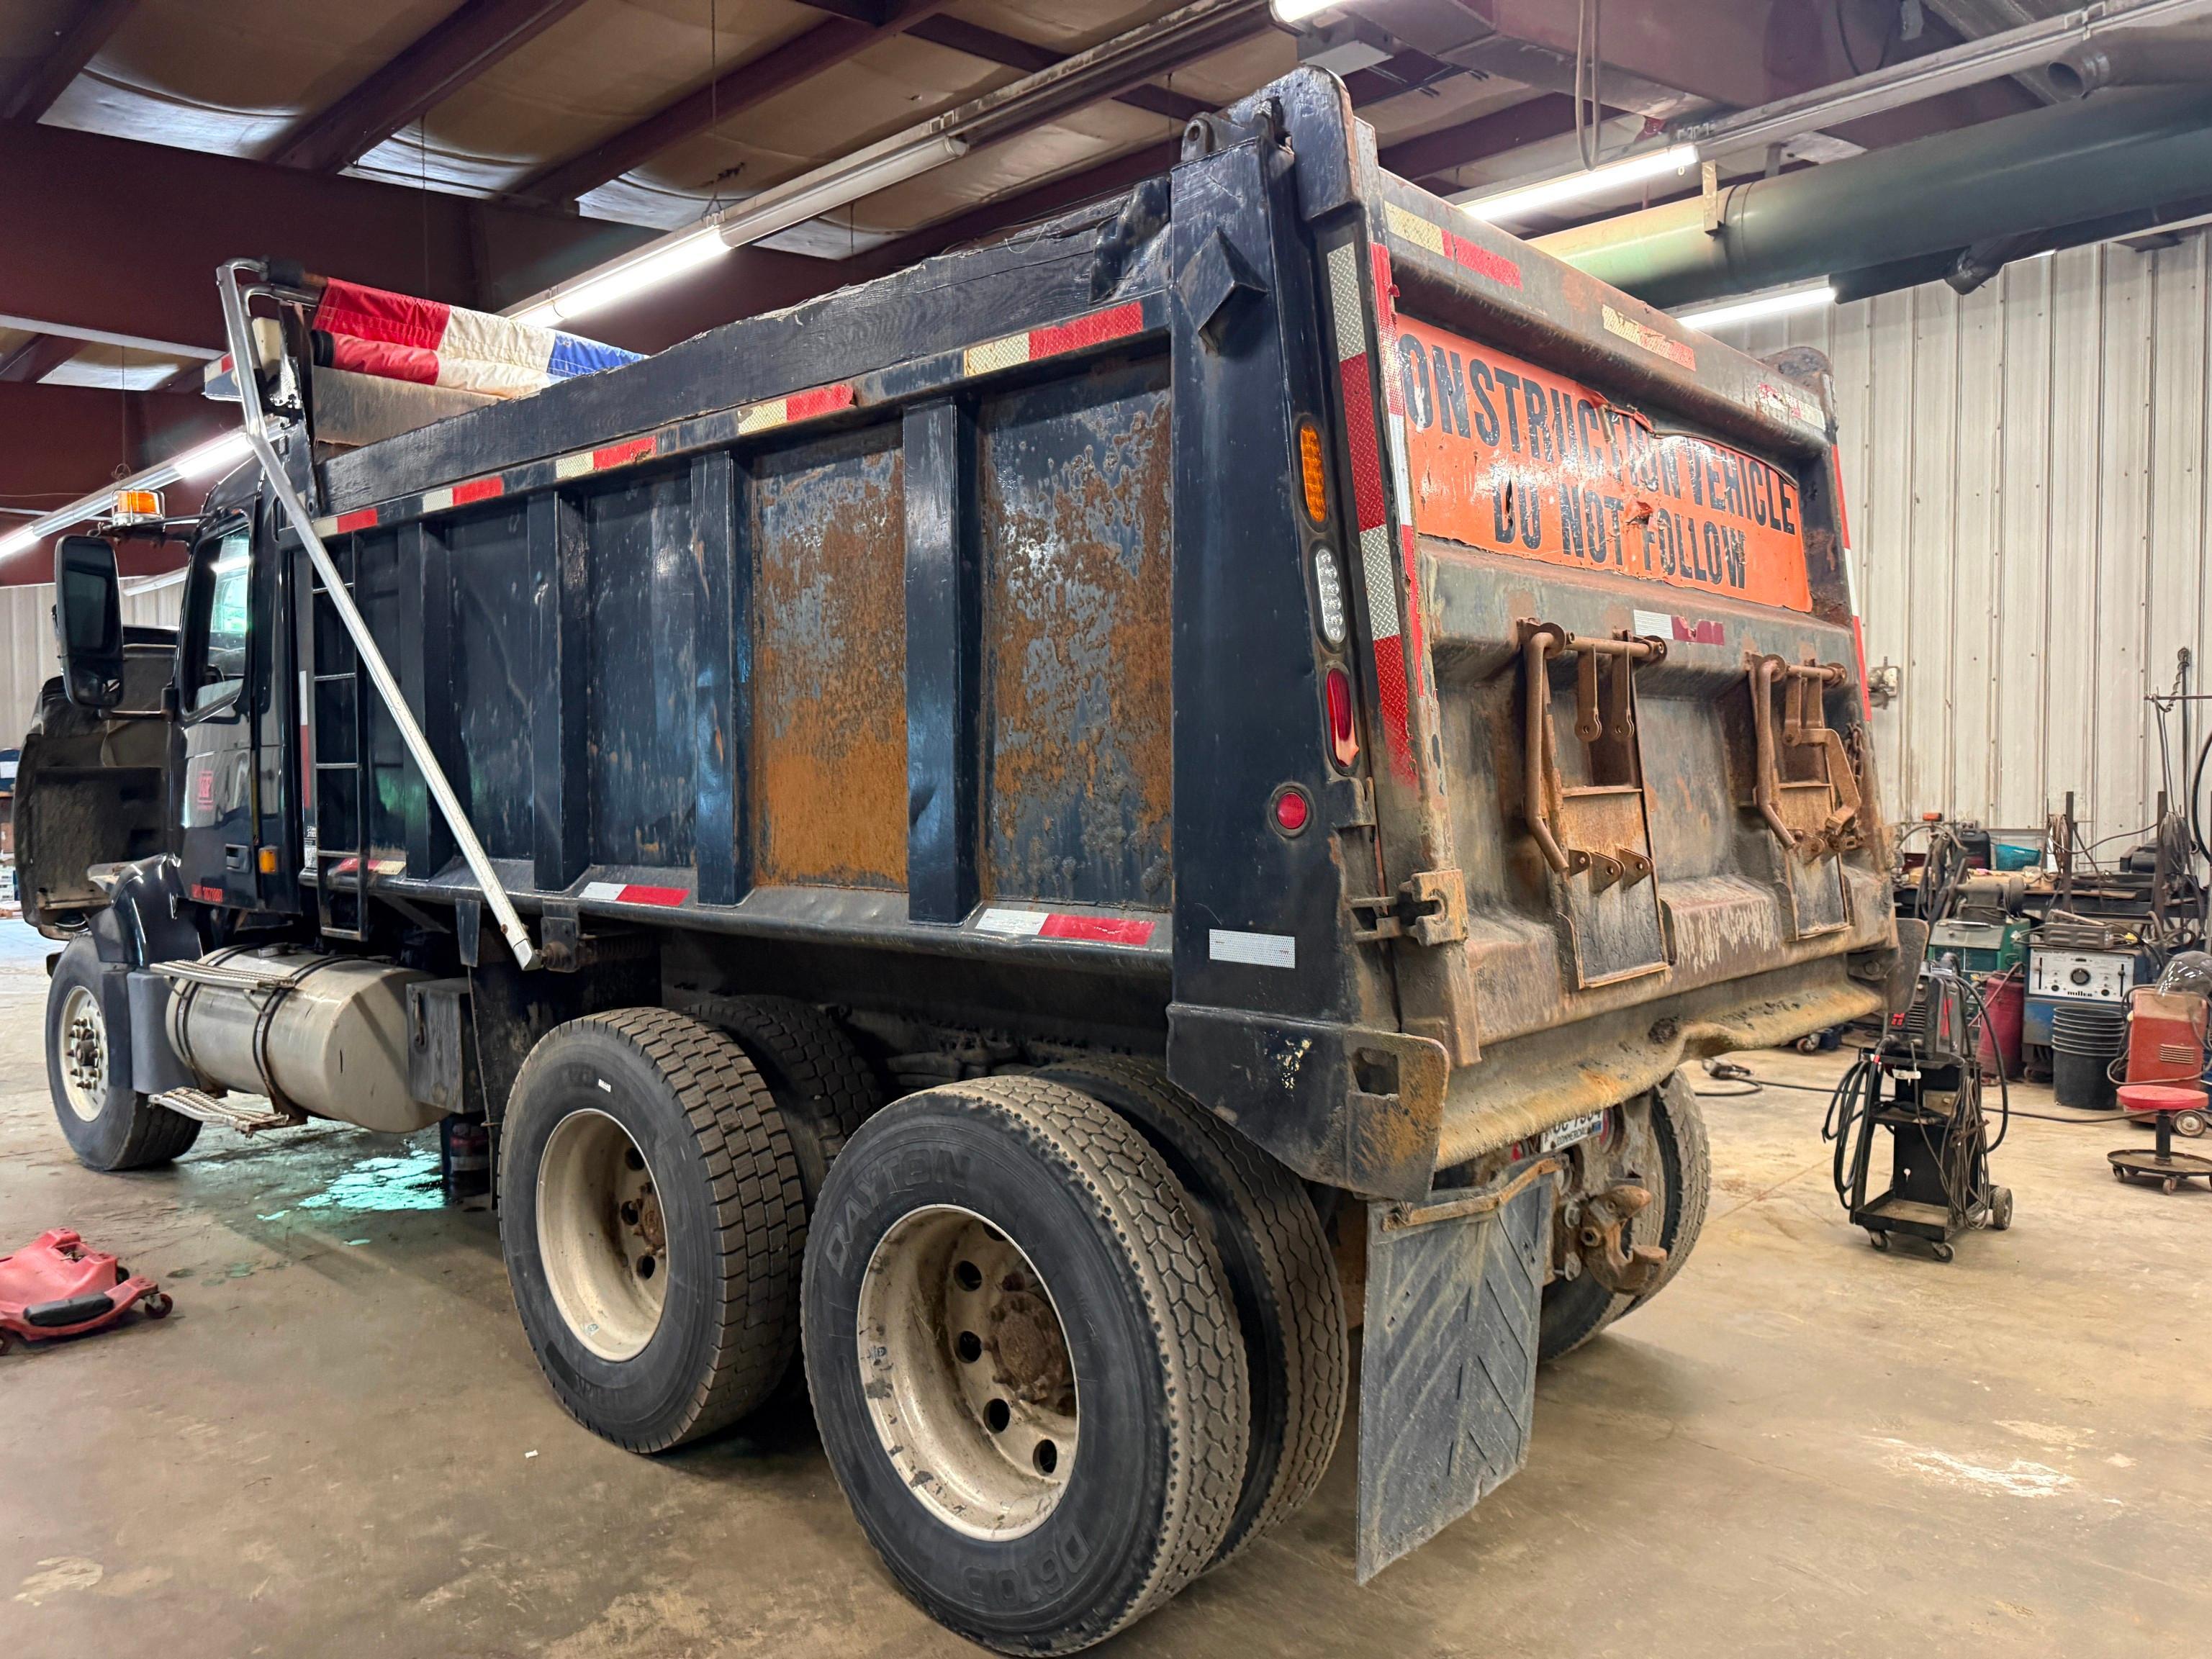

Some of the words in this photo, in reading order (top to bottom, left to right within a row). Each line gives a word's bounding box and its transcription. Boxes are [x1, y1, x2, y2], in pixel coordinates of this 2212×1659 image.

[1491, 466, 1542, 550] DO
[1558, 483, 1625, 566] NOT
[1642, 507, 1746, 589] FOLLOW
[1685, 435, 1796, 535] VEHICLE
[825, 1148, 972, 1278] DAYTON
